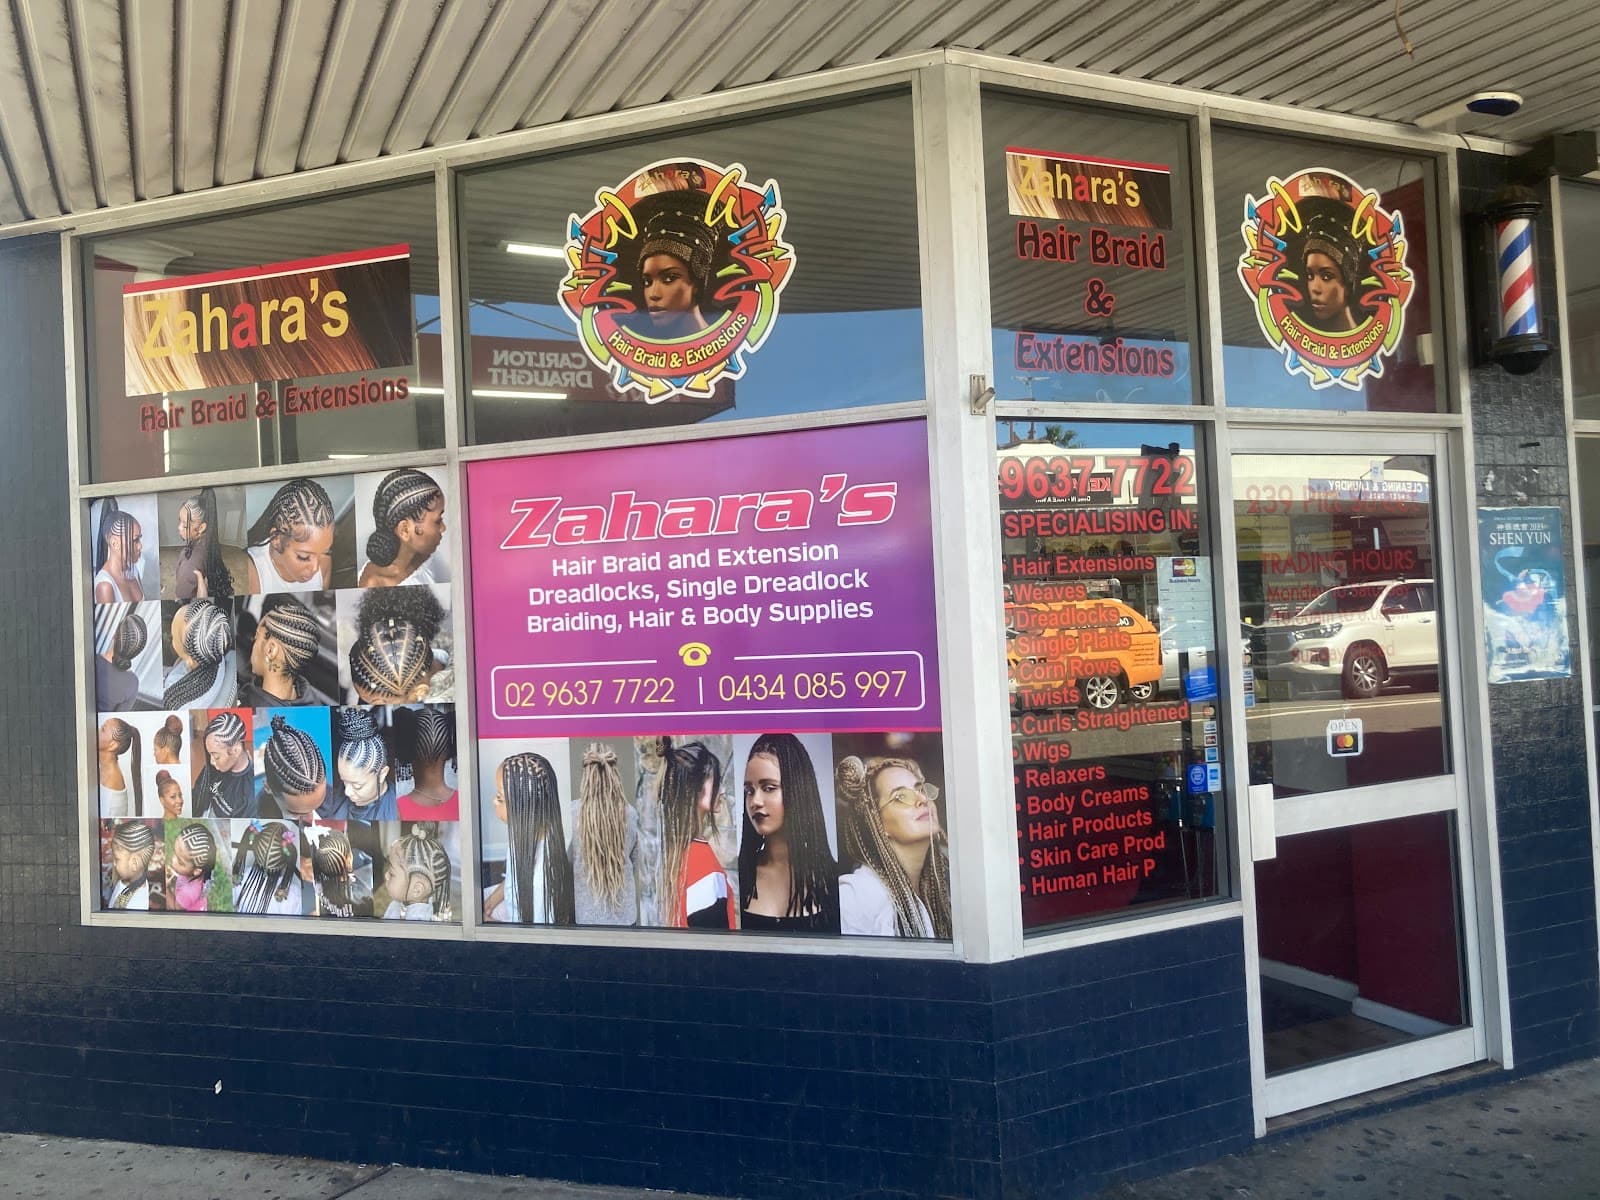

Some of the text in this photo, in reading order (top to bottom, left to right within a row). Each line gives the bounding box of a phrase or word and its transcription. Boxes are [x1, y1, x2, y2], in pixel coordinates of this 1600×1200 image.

[1019, 159, 1140, 208] Zahara's
[1017, 222, 1166, 270] Hair Braid
[1085, 279, 1115, 316] &
[143, 278, 349, 359] Zahara's
[607, 313, 748, 368] Hair Braid & Extensions
[1280, 316, 1384, 359] Hair Braid & Extensions
[1015, 331, 1175, 378] Extensions
[140, 376, 409, 432] Hair Braid & Extensions
[1000, 456, 1195, 499] 9637 7722
[500, 473, 898, 550] Zahara's
[1004, 509, 1199, 538] SPECIALISING IN:
[1490, 531, 1551, 545] SHEN YUN
[552, 542, 839, 577] Hair Braid and Extension
[1012, 555, 1155, 576] Hair Extensions
[1262, 550, 1416, 574] TRADING HOURS
[529, 569, 869, 606] Dreadlocks, Single Dreadlock
[1014, 583, 1085, 601] Weaves
[527, 599, 874, 635] Braiding, Hair & Body Supplies
[1016, 607, 1118, 628] Dreadlocks
[1017, 632, 1130, 657] Single Plaits
[719, 670, 907, 701] 0434 085 997
[1020, 661, 1065, 681] Corn
[1070, 658, 1120, 675] Rows
[505, 677, 675, 707] 02 9637 7722
[1021, 687, 1079, 707] Twists
[1022, 715, 1071, 735] Curls
[1077, 703, 1190, 730] Straightened
[1331, 721, 1358, 730] OPEN
[1023, 742, 1070, 763] Wigs
[1025, 765, 1106, 788] Relaxers
[1027, 785, 1149, 815] Body Creams
[1029, 810, 1153, 842] Hair Products
[1030, 831, 1165, 869] Skin Care Prod
[1032, 859, 1156, 896] Human Hair P
